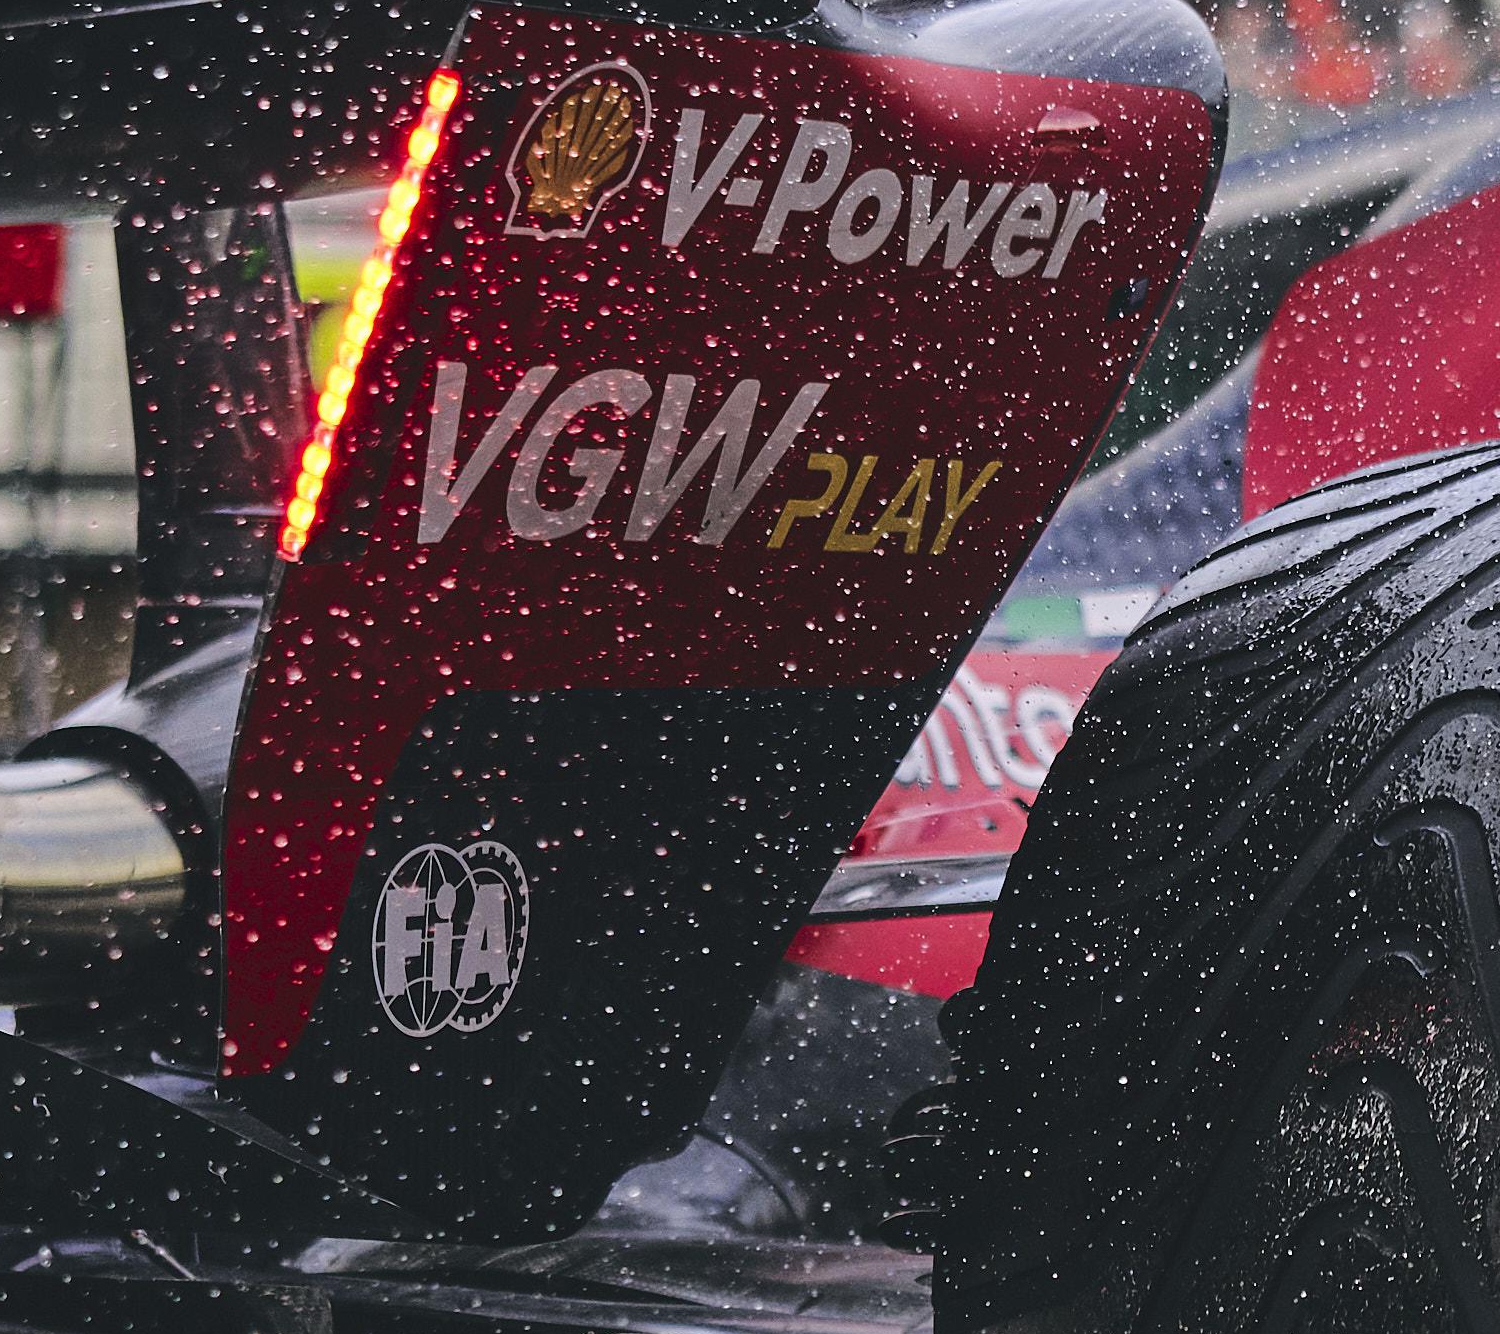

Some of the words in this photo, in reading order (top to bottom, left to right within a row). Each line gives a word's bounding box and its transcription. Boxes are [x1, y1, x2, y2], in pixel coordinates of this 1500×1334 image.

[660, 107, 1108, 280] V-Power
[416, 361, 831, 547] VGW
[766, 452, 1003, 555] PLAY
